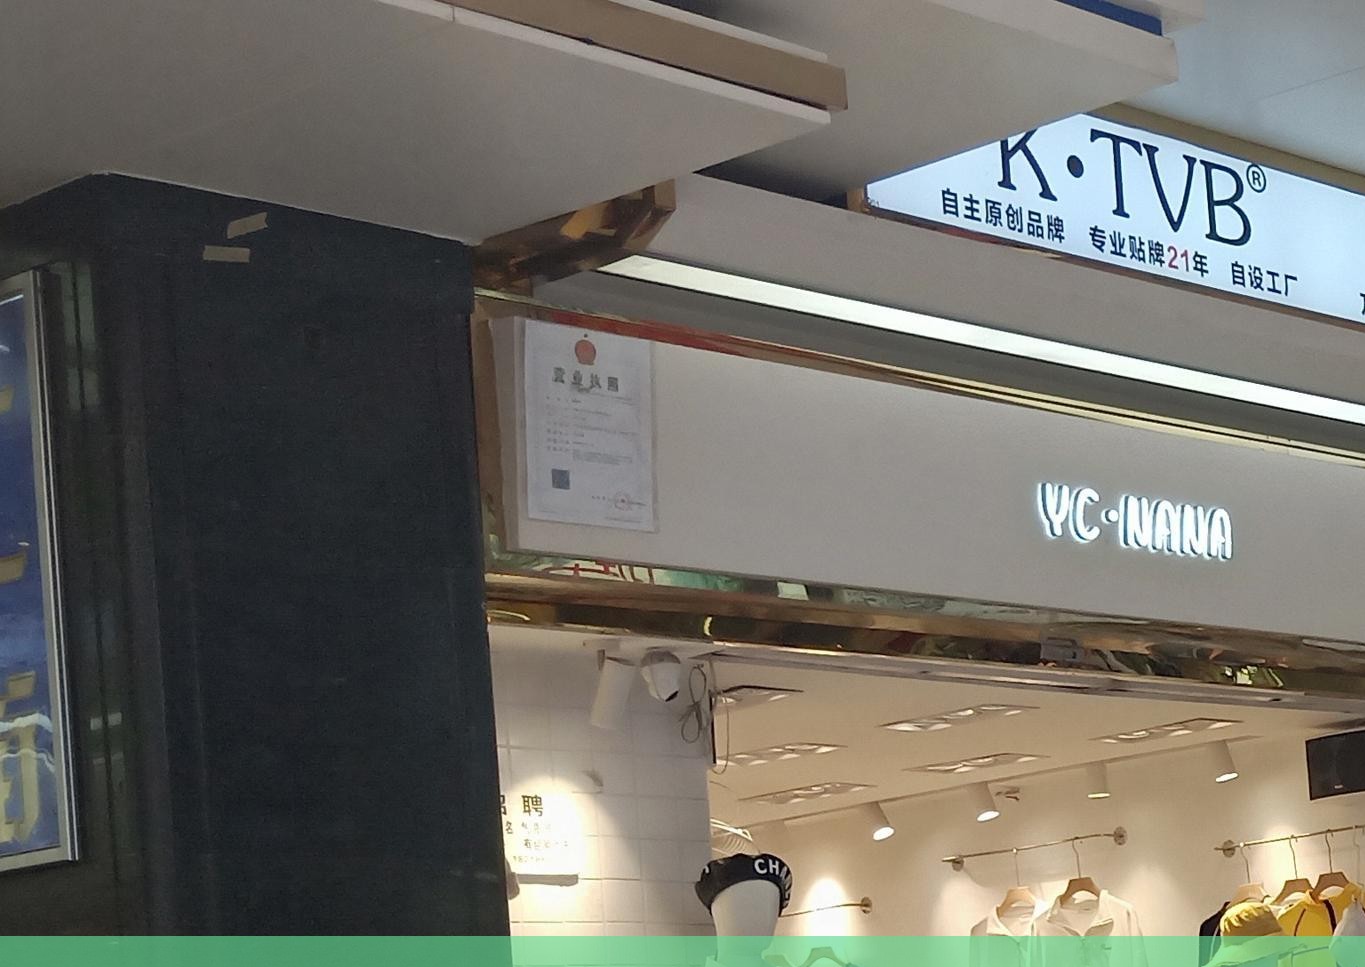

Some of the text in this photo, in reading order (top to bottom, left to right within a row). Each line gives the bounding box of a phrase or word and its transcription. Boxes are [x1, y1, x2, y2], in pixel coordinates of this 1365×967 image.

[941, 188, 1299, 297] 自主原创品牌 专业贴牌21年 自设工厂
